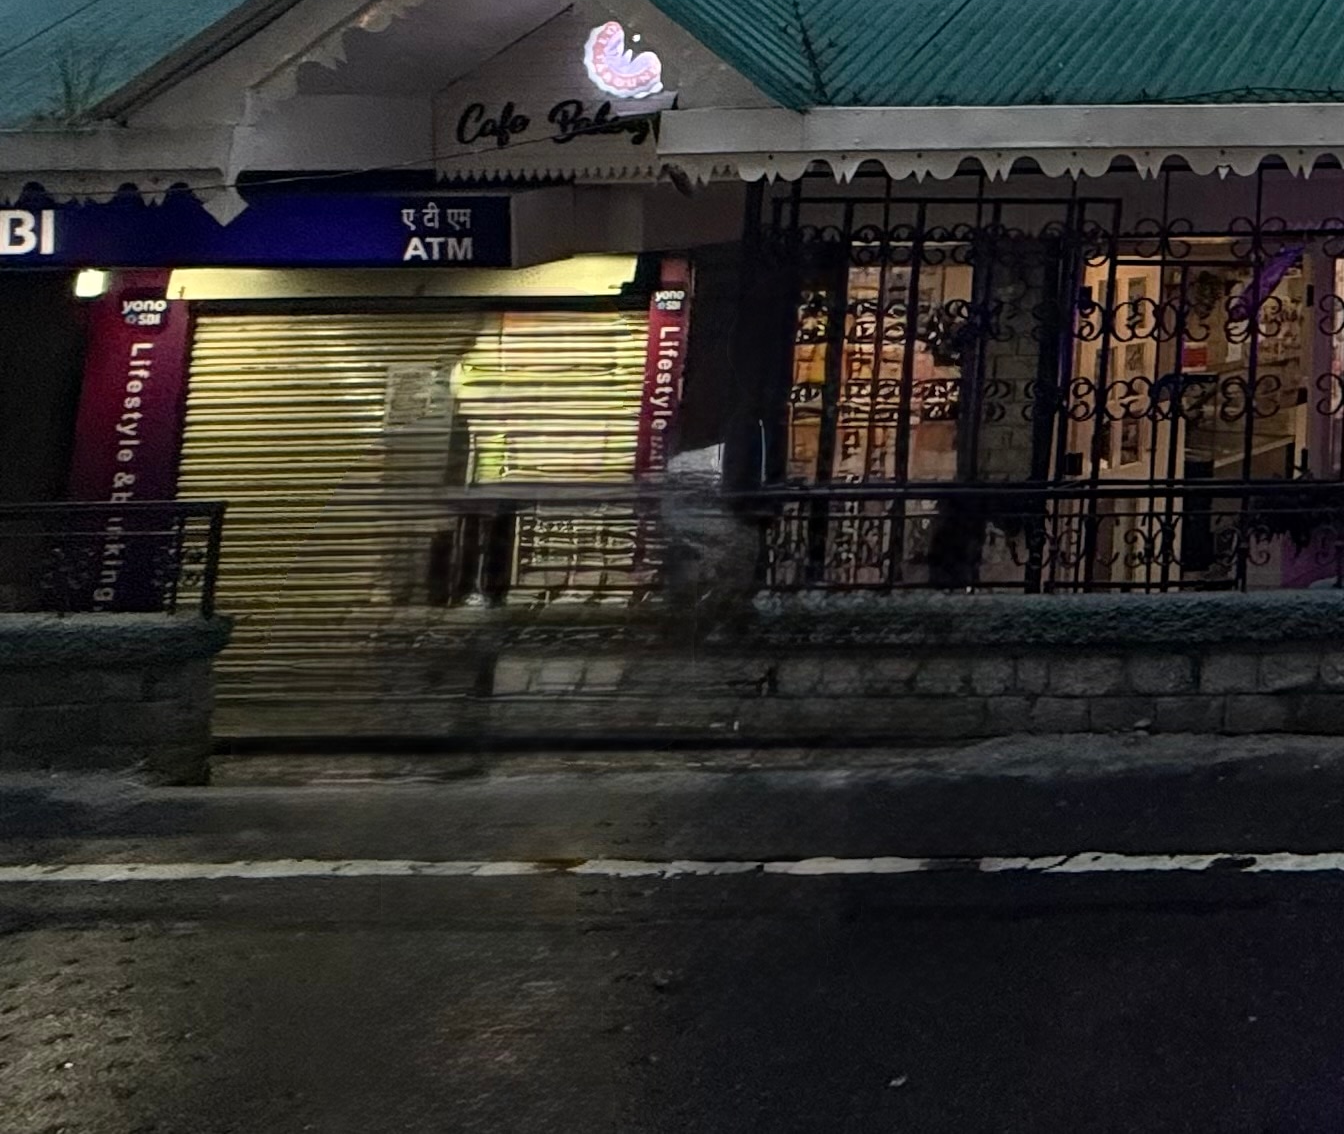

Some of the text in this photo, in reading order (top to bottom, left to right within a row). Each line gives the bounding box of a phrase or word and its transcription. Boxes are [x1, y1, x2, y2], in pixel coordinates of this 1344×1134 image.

[456, 102, 530, 147] Cafe
[401, 201, 472, 231] ए टी एम
[403, 237, 473, 261] ATM
[121, 299, 168, 315] yono
[655, 290, 685, 303] yono
[650, 326, 682, 431] Lifestyle
[93, 342, 154, 610] Lifestyle & bnking
